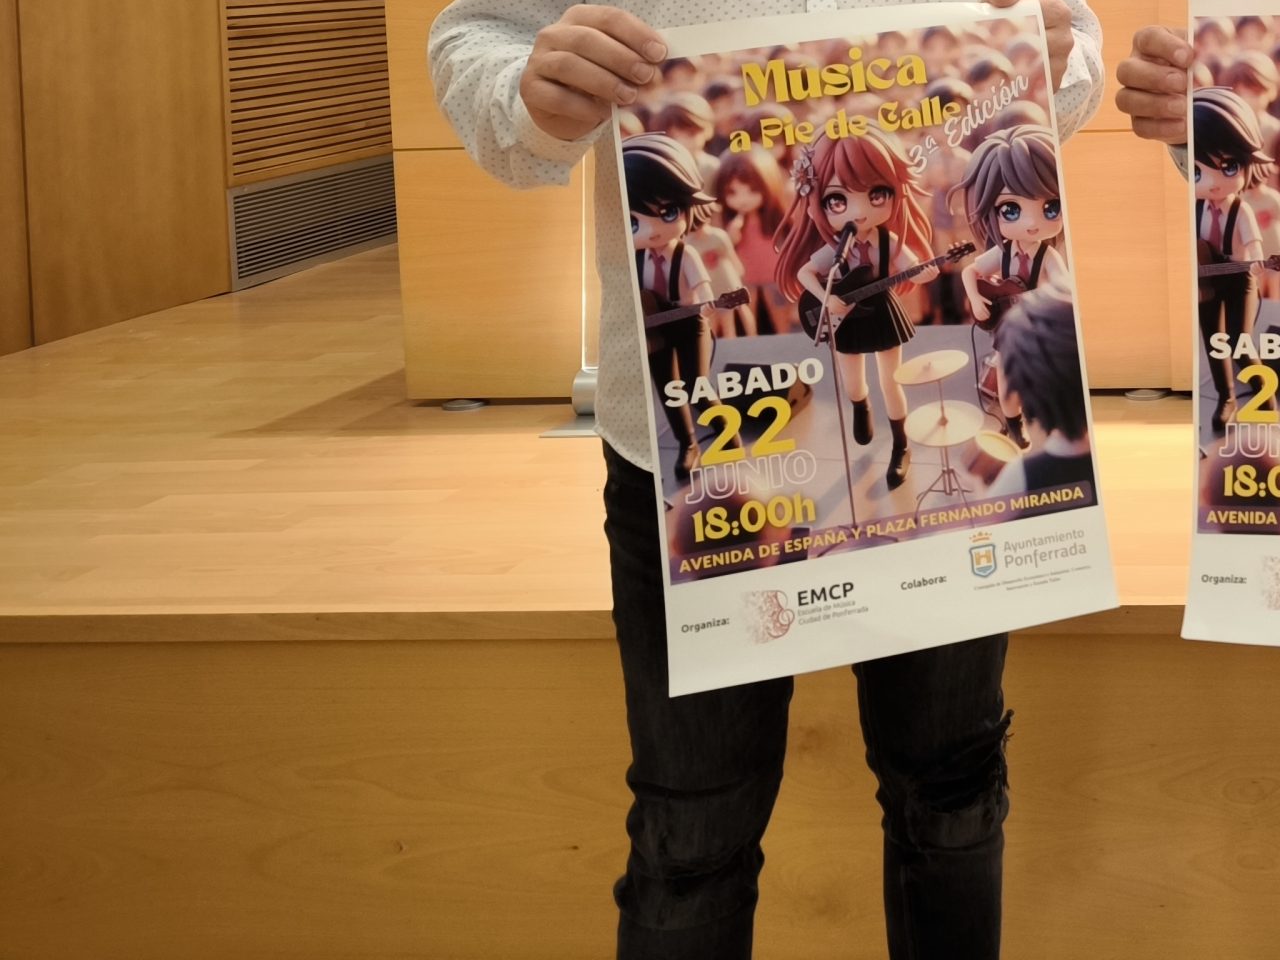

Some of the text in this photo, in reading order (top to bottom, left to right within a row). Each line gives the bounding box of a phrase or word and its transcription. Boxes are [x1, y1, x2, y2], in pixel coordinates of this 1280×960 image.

[729, 96, 961, 154] a Pie de Calle
[944, 75, 1029, 148] Edición
[664, 357, 824, 408] SABADO
[697, 396, 796, 466] 22
[685, 449, 817, 505] JUNIO
[679, 486, 1085, 573] AVENIDA DE ESPAÑA Y PLAZA FERNANDO MIRANDA
[692, 493, 816, 543] 18:00h
[1206, 510, 1277, 525] AVENIDA
[1003, 528, 1085, 554] Ayuntamiento
[1004, 542, 1087, 569] Ponferrada
[797, 582, 854, 607] EMCP
[901, 575, 947, 591] Colabora:
[1201, 574, 1247, 585] Organiza:
[681, 617, 730, 634] Organiza:
